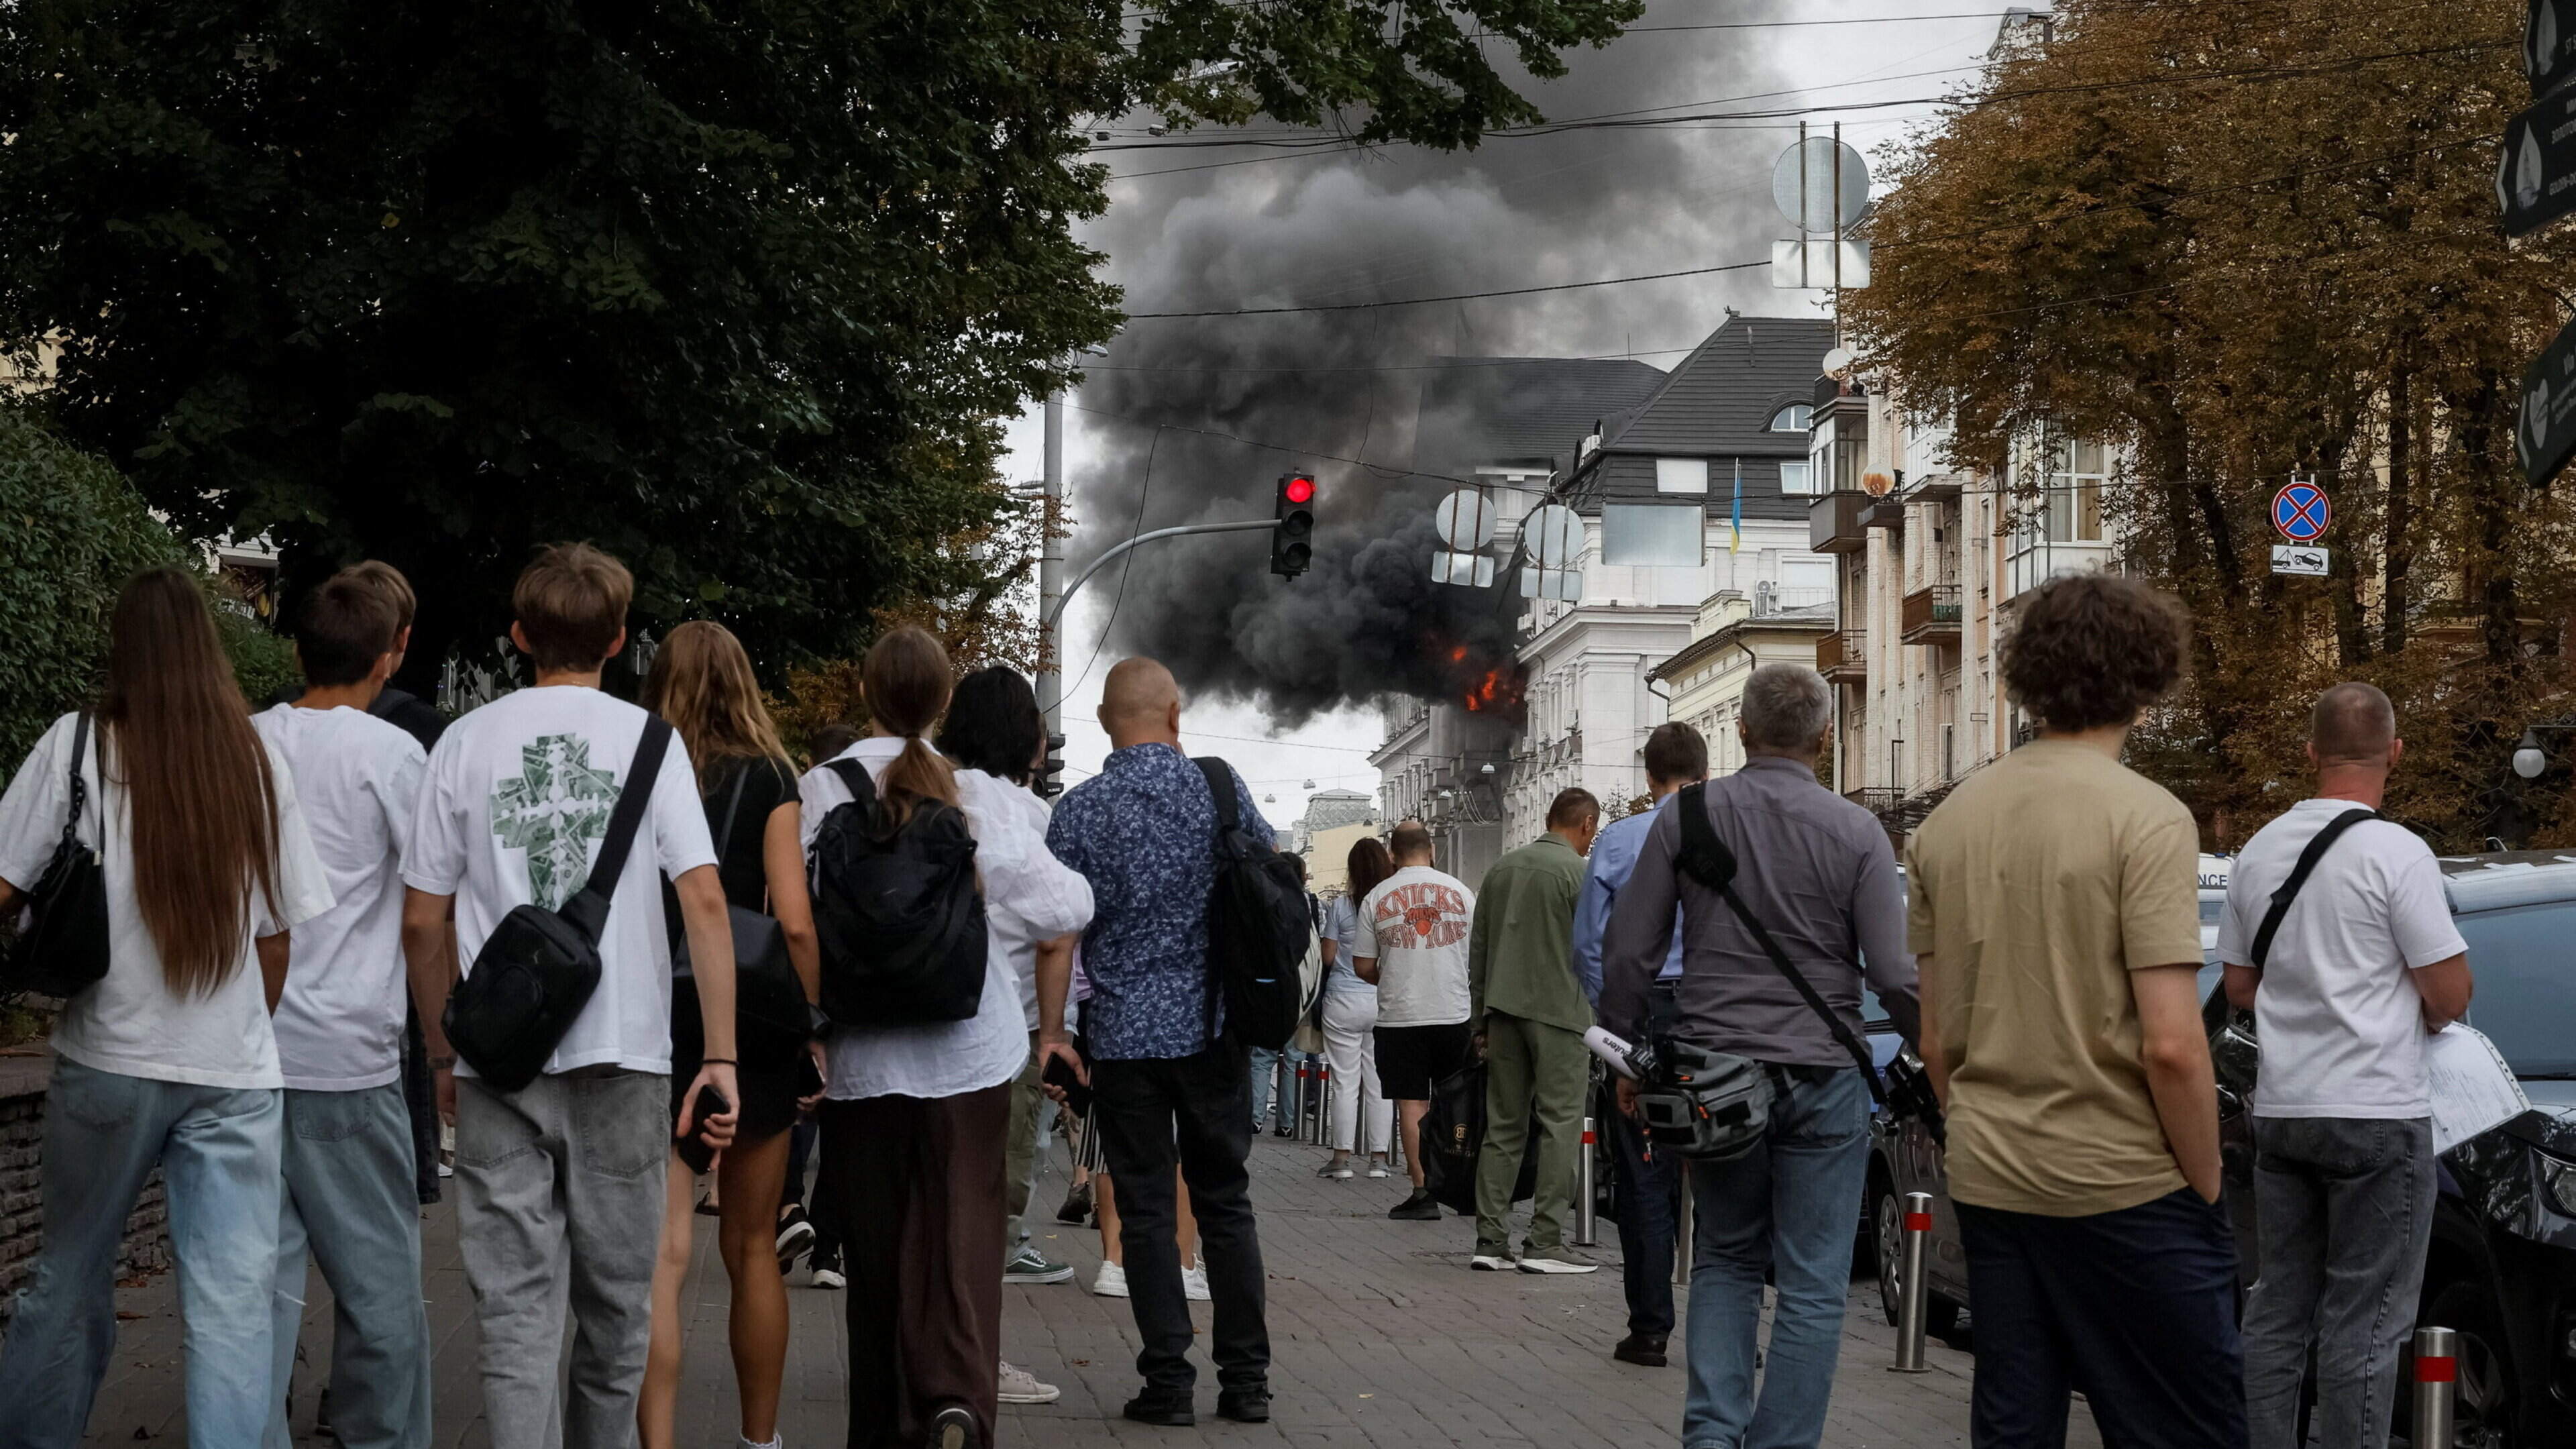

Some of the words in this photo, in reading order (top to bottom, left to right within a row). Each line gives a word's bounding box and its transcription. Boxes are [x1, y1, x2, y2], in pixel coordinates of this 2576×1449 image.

[1376, 882, 1466, 922] KNICKS
[1377, 924, 1416, 949] NEW
[1426, 920, 1468, 949] YORK
